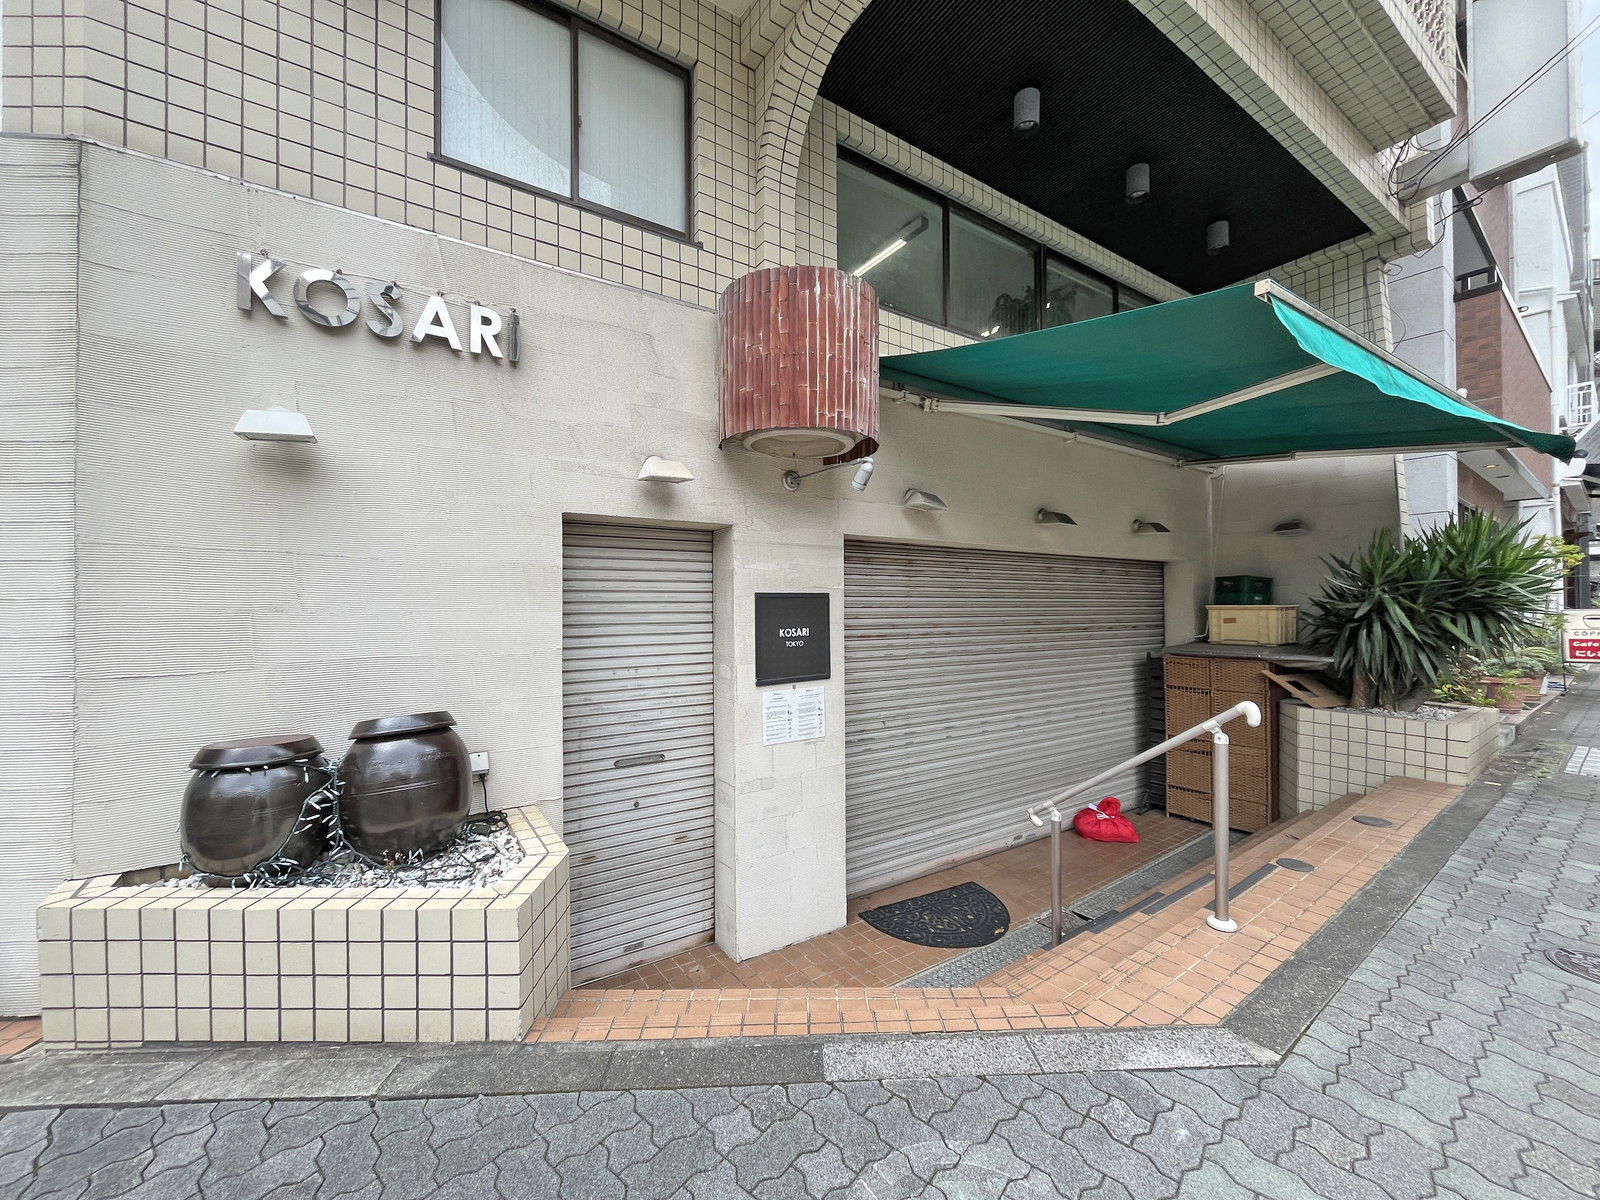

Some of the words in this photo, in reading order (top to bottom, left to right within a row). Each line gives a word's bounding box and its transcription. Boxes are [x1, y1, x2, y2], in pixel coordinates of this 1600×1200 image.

[236, 251, 521, 362] KOSARI
[779, 627, 810, 638] KOSARI
[785, 640, 805, 648] TOKYO
